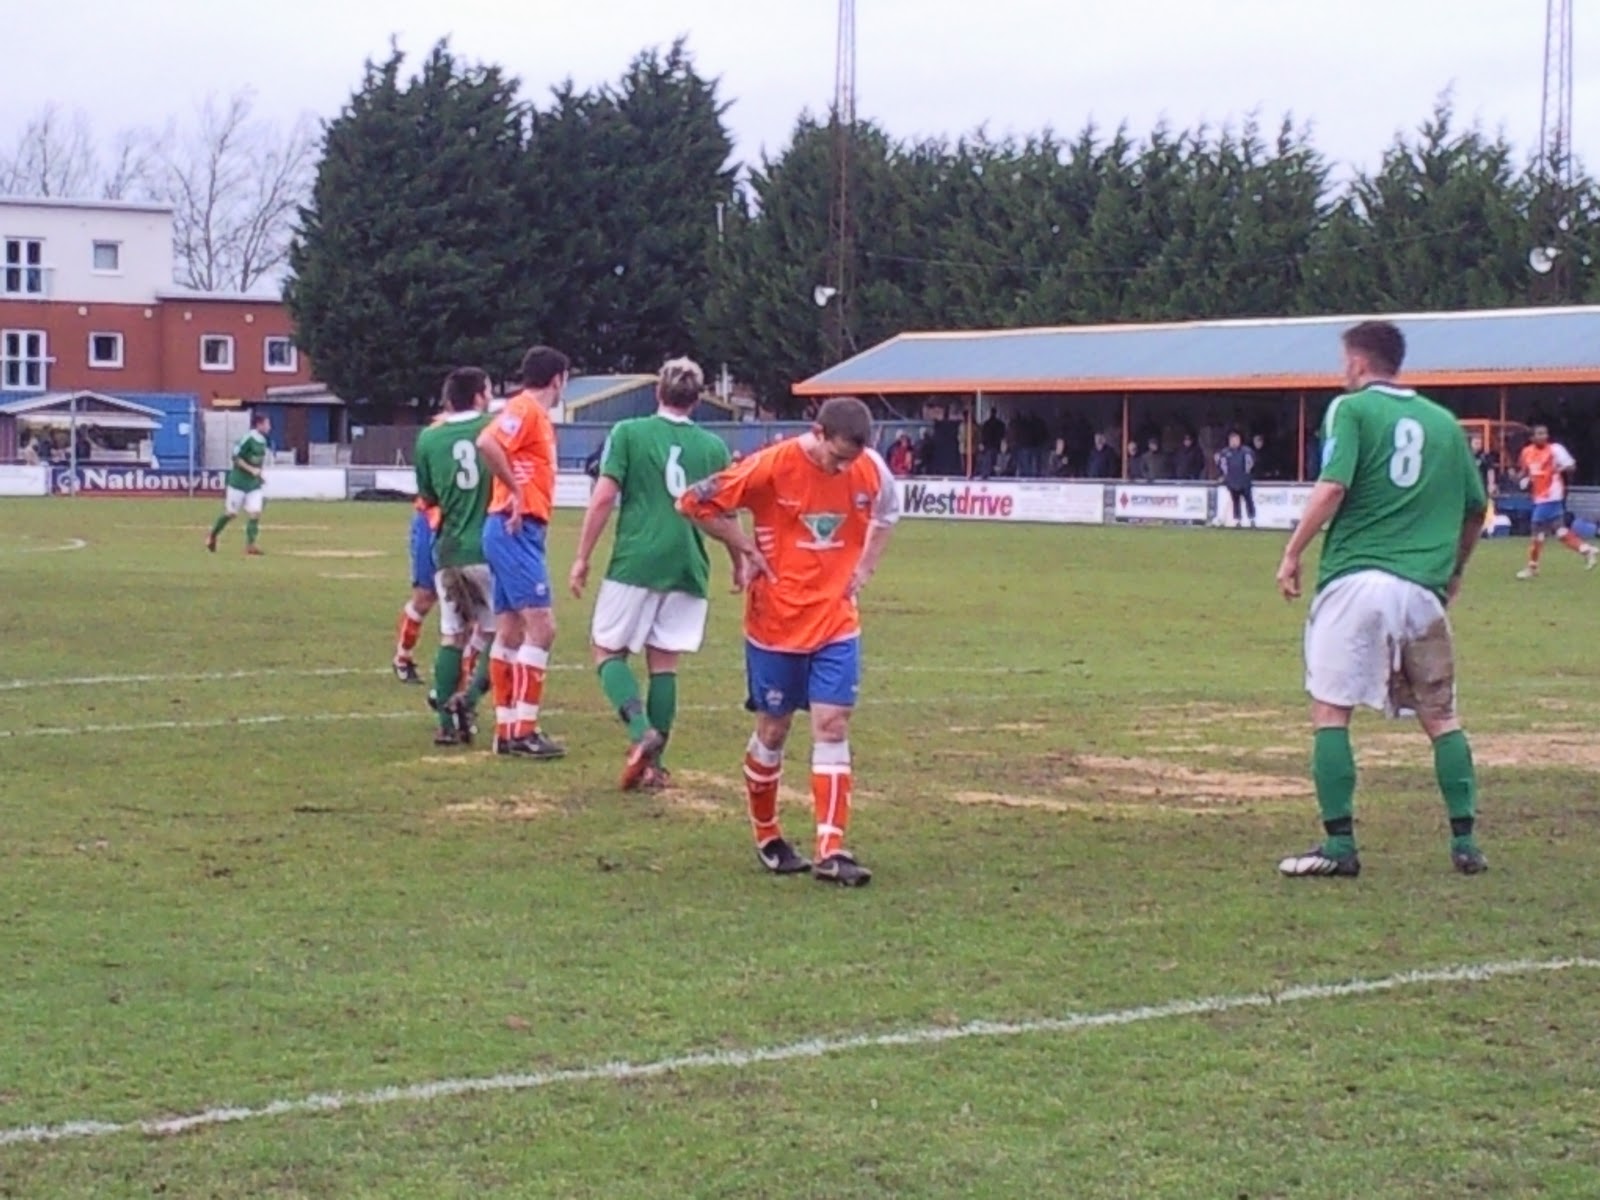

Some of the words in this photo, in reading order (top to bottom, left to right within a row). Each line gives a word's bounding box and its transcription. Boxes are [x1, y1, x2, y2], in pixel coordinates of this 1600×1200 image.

[453, 440, 478, 489] 3
[664, 445, 687, 498] 6
[1391, 418, 1423, 487] 8
[83, 469, 226, 490] Nationwid
[904, 482, 1013, 520] Westdrive
